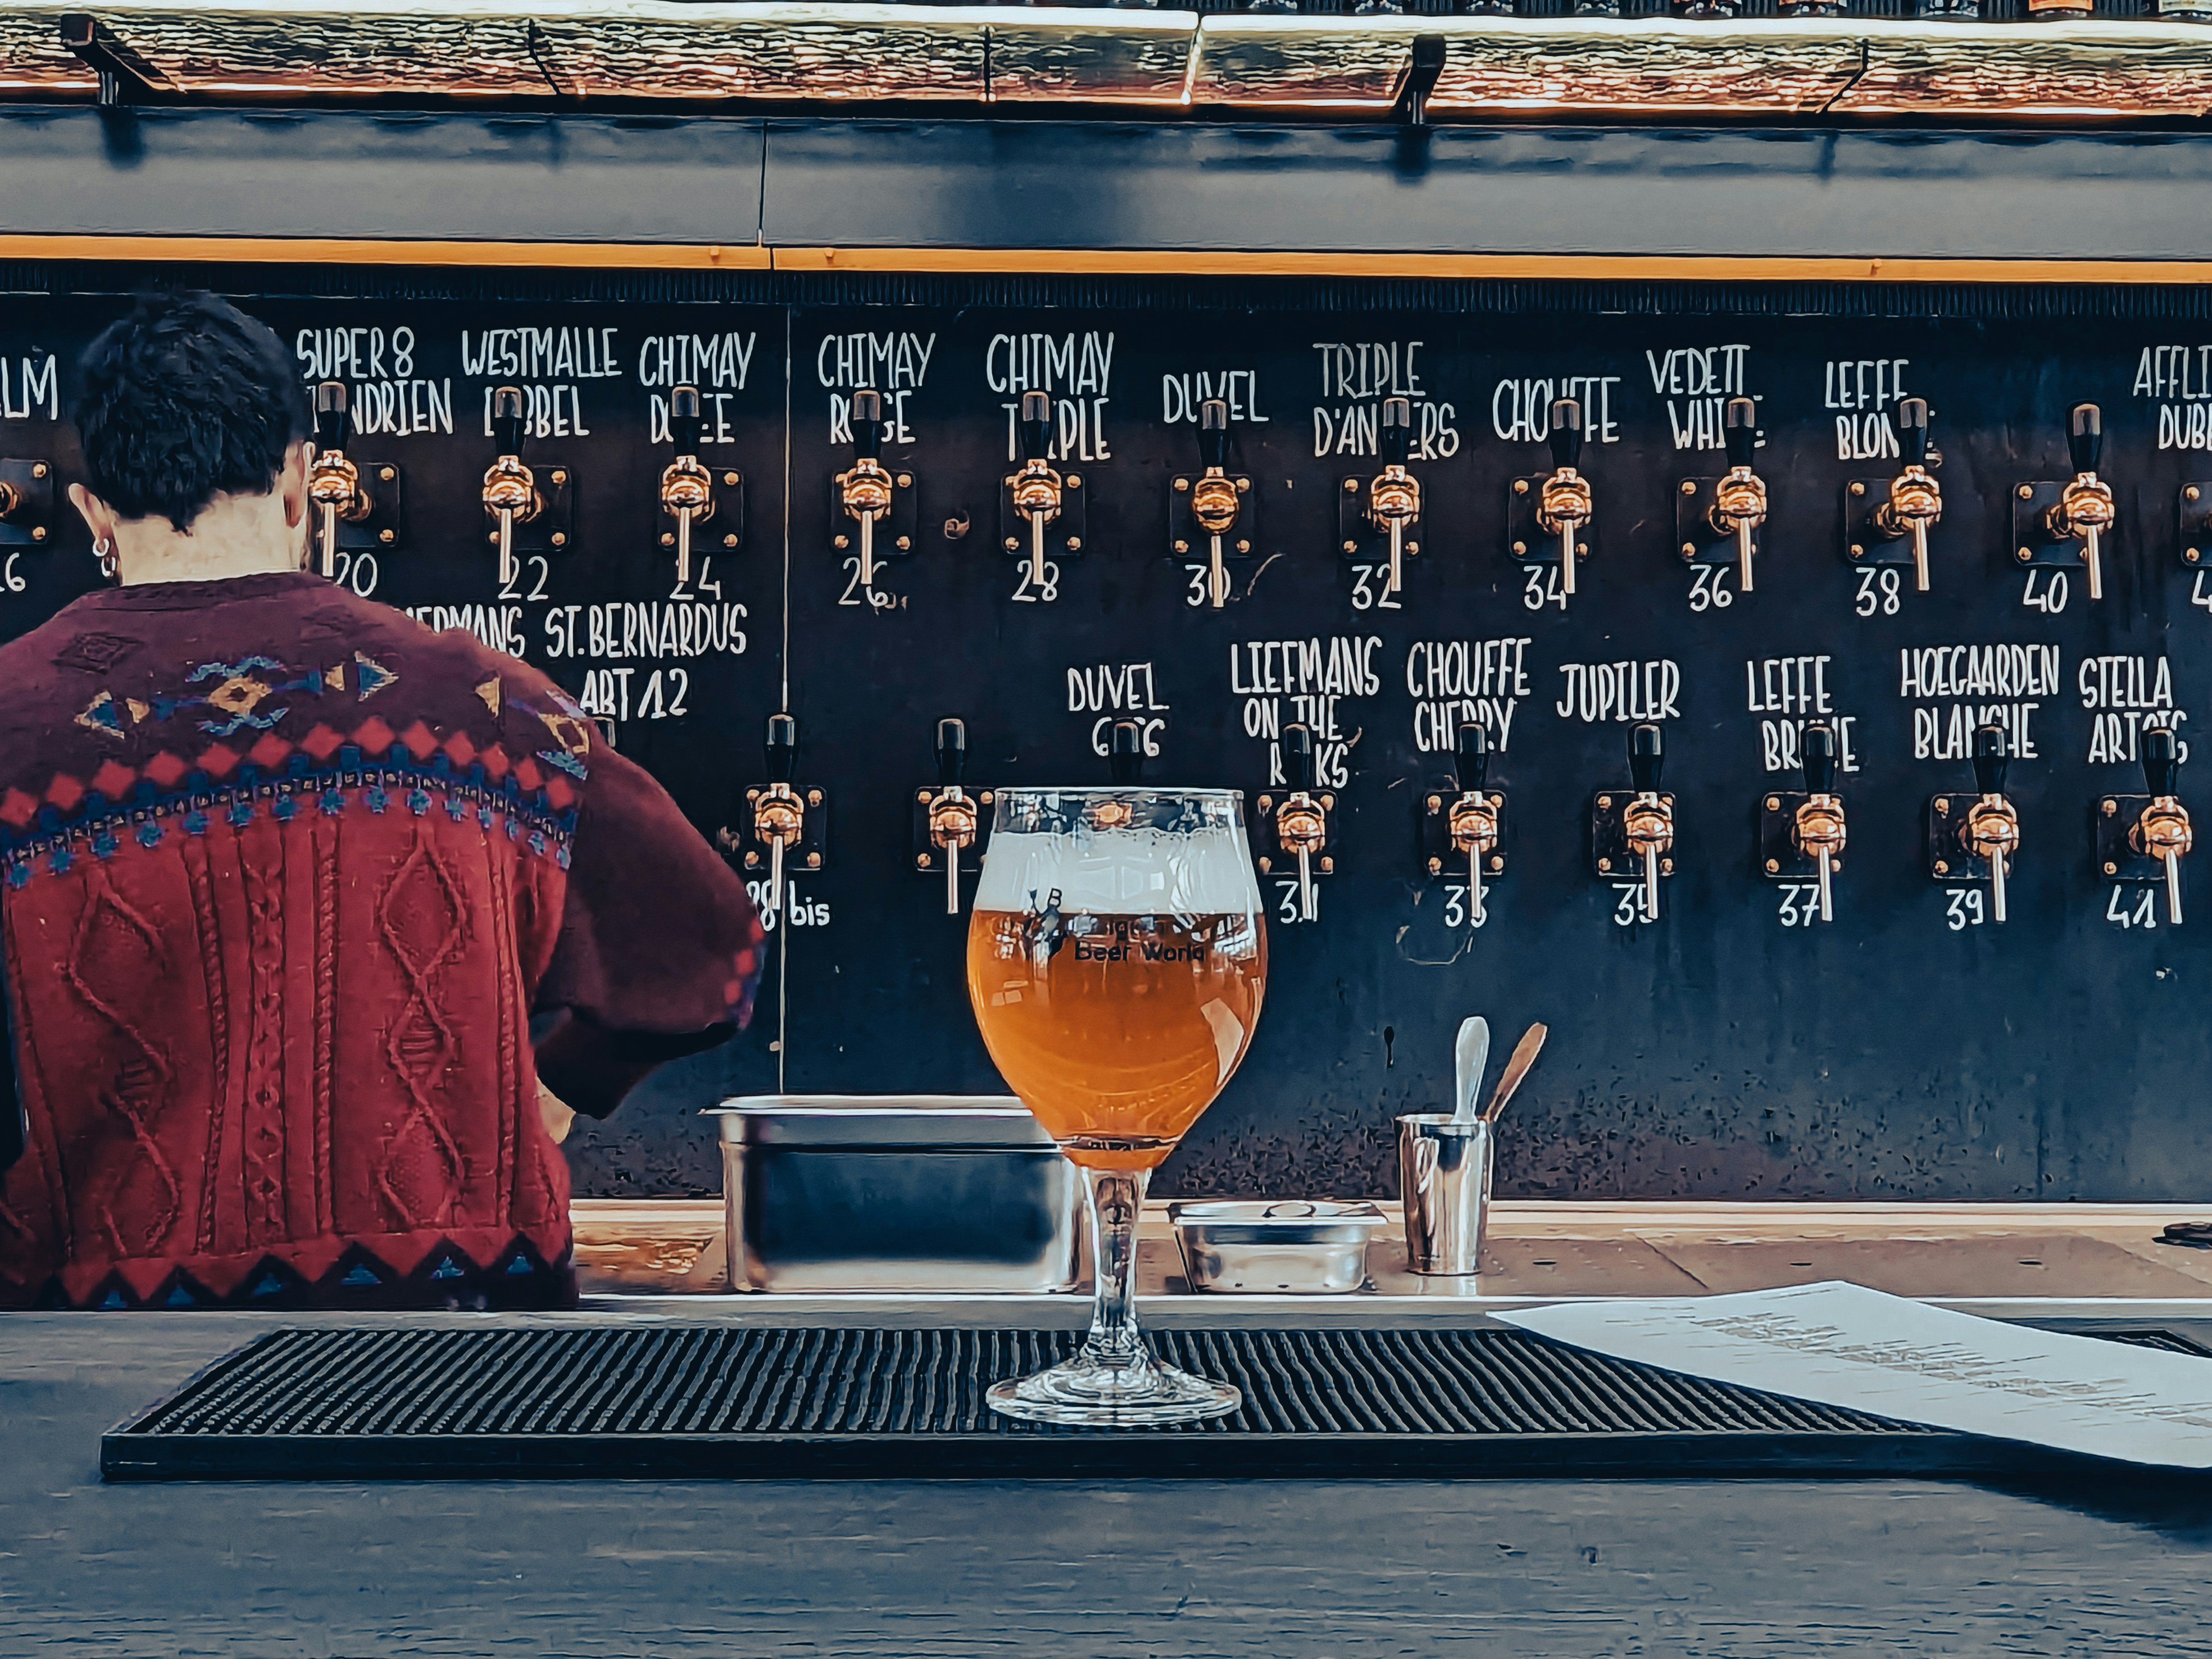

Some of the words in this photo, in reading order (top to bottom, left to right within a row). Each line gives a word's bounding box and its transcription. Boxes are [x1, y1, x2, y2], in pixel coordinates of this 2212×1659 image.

[297, 328, 388, 379] SUPER
[393, 326, 415, 375] 8
[462, 327, 622, 378] WESTMALLE
[639, 332, 756, 389] CHIMAY
[818, 332, 936, 389] CHIMAY
[986, 331, 1114, 395] CHIMAY
[1312, 341, 1426, 399] TRIPLE
[1646, 344, 1751, 395] VEDETT
[1163, 370, 1269, 423] DUVEL
[1011, 560, 1060, 602] 28
[1352, 564, 1402, 611] 32
[1523, 565, 1566, 611] 34
[1689, 564, 1733, 612] 36
[1855, 567, 1901, 616] 38
[2023, 569, 2068, 613] 40
[544, 602, 747, 658] ST.BERNARDUS
[1067, 662, 1170, 712] DUVEL
[1231, 636, 1383, 696] LIEFMANS
[1406, 638, 1532, 697] CHOUFFE
[1556, 659, 1680, 722] JUPILER
[1747, 655, 1833, 714] LEFFE
[1900, 644, 2060, 698] HOEGAARDEN
[2079, 656, 2173, 708] STELLA
[579, 668, 634, 721] ABT
[638, 668, 688, 719] 12
[1243, 697, 1279, 739] ON
[1289, 695, 1343, 741] THE
[1092, 716, 1165, 757] 66
[1270, 743, 1348, 789] RKS
[788, 880, 830, 926] bis
[1778, 884, 1820, 928] 37
[1946, 889, 1984, 931] 39
[2106, 885, 2157, 928] 41
[1075, 940, 1132, 961] Beer
